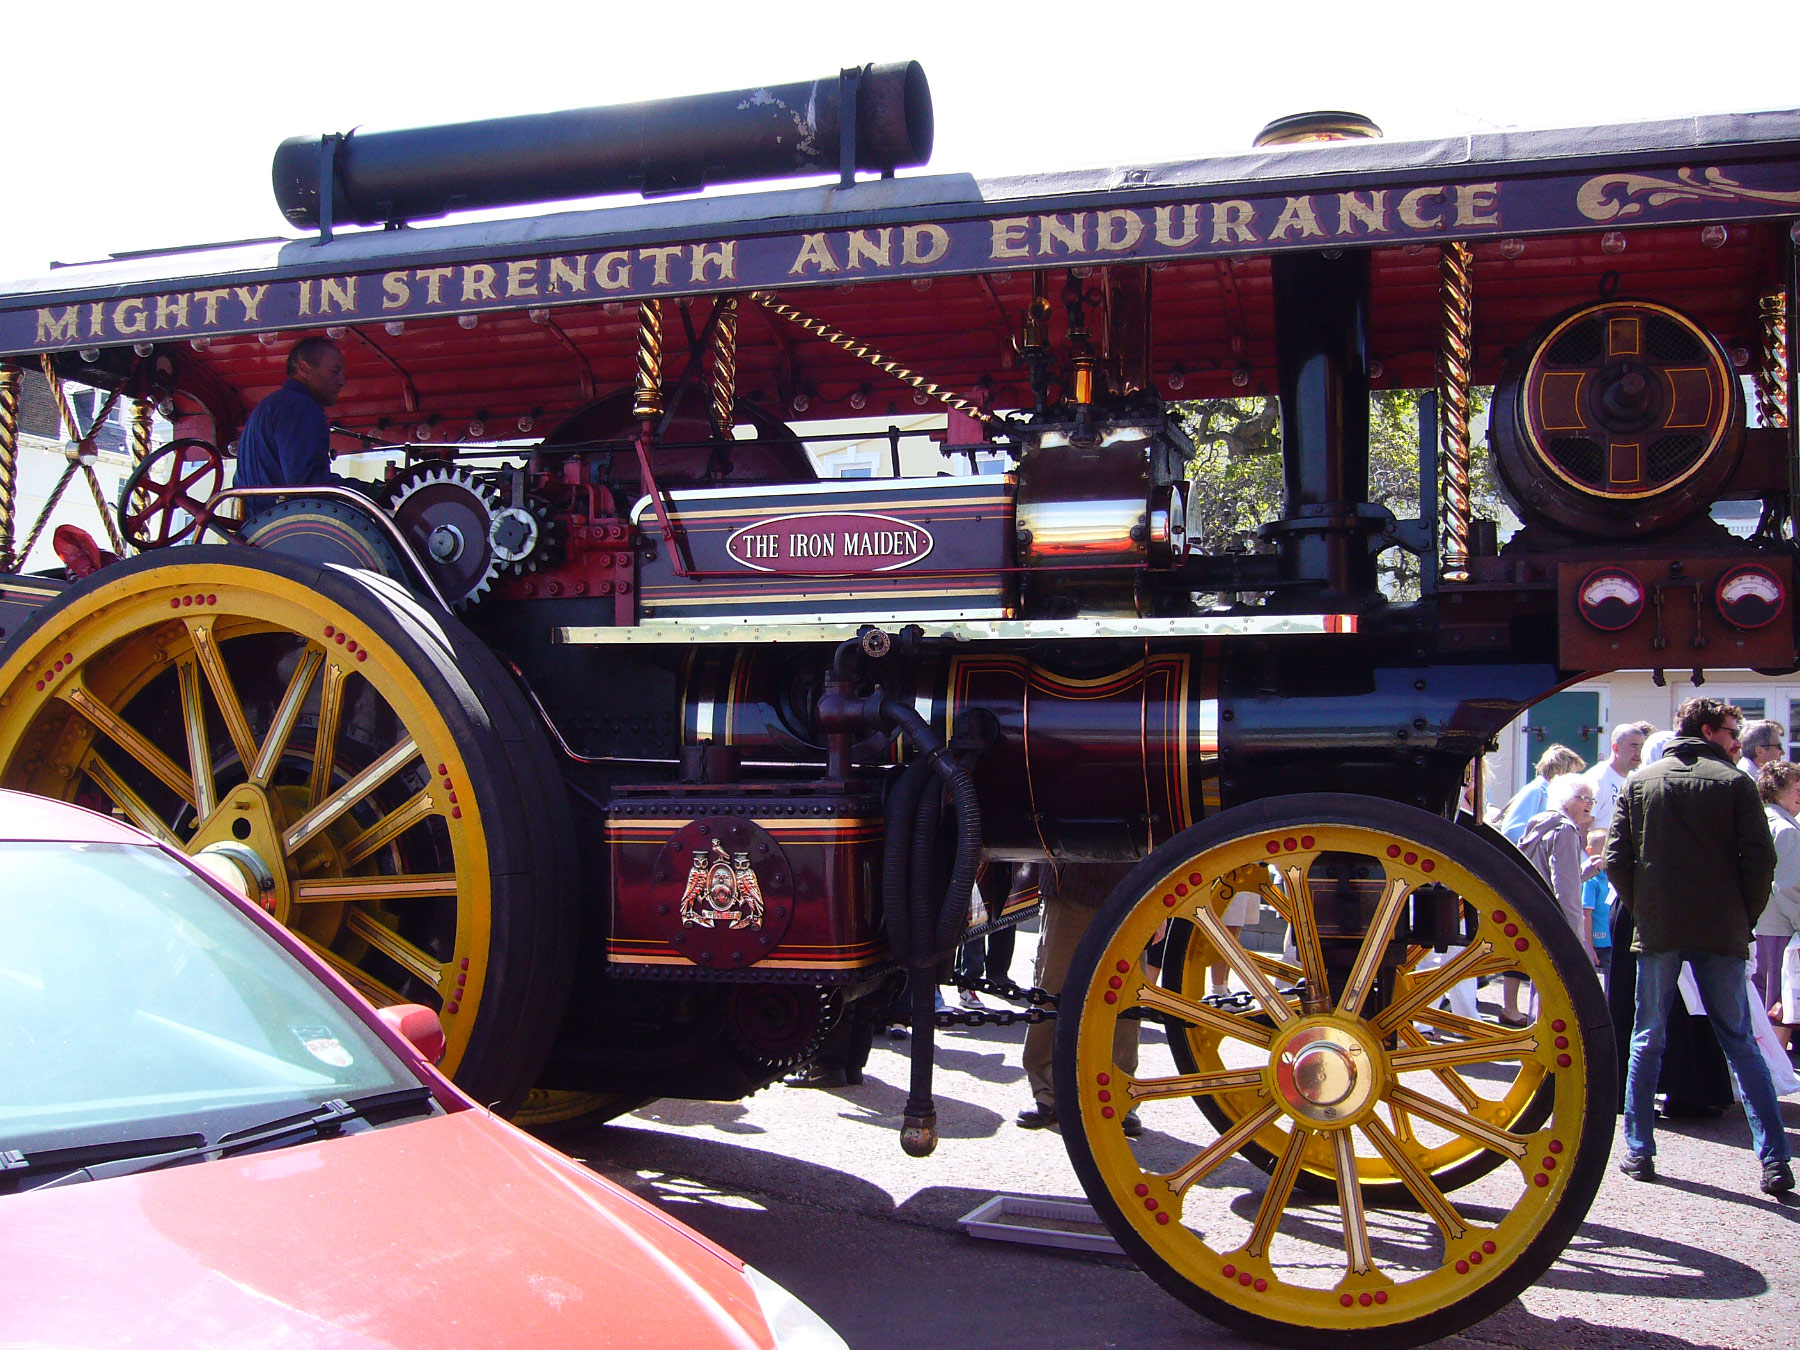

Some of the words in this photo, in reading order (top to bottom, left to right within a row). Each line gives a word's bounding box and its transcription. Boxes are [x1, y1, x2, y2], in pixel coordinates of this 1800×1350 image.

[34, 285, 270, 344] MIGHTY
[298, 276, 359, 316] IN
[382, 241, 737, 310] STRENGTH
[788, 222, 950, 275] AND
[989, 182, 1499, 260] ENDURANCE
[742, 534, 779, 558] THE
[789, 532, 835, 558] IRON
[843, 530, 918, 556] MAIDEN
